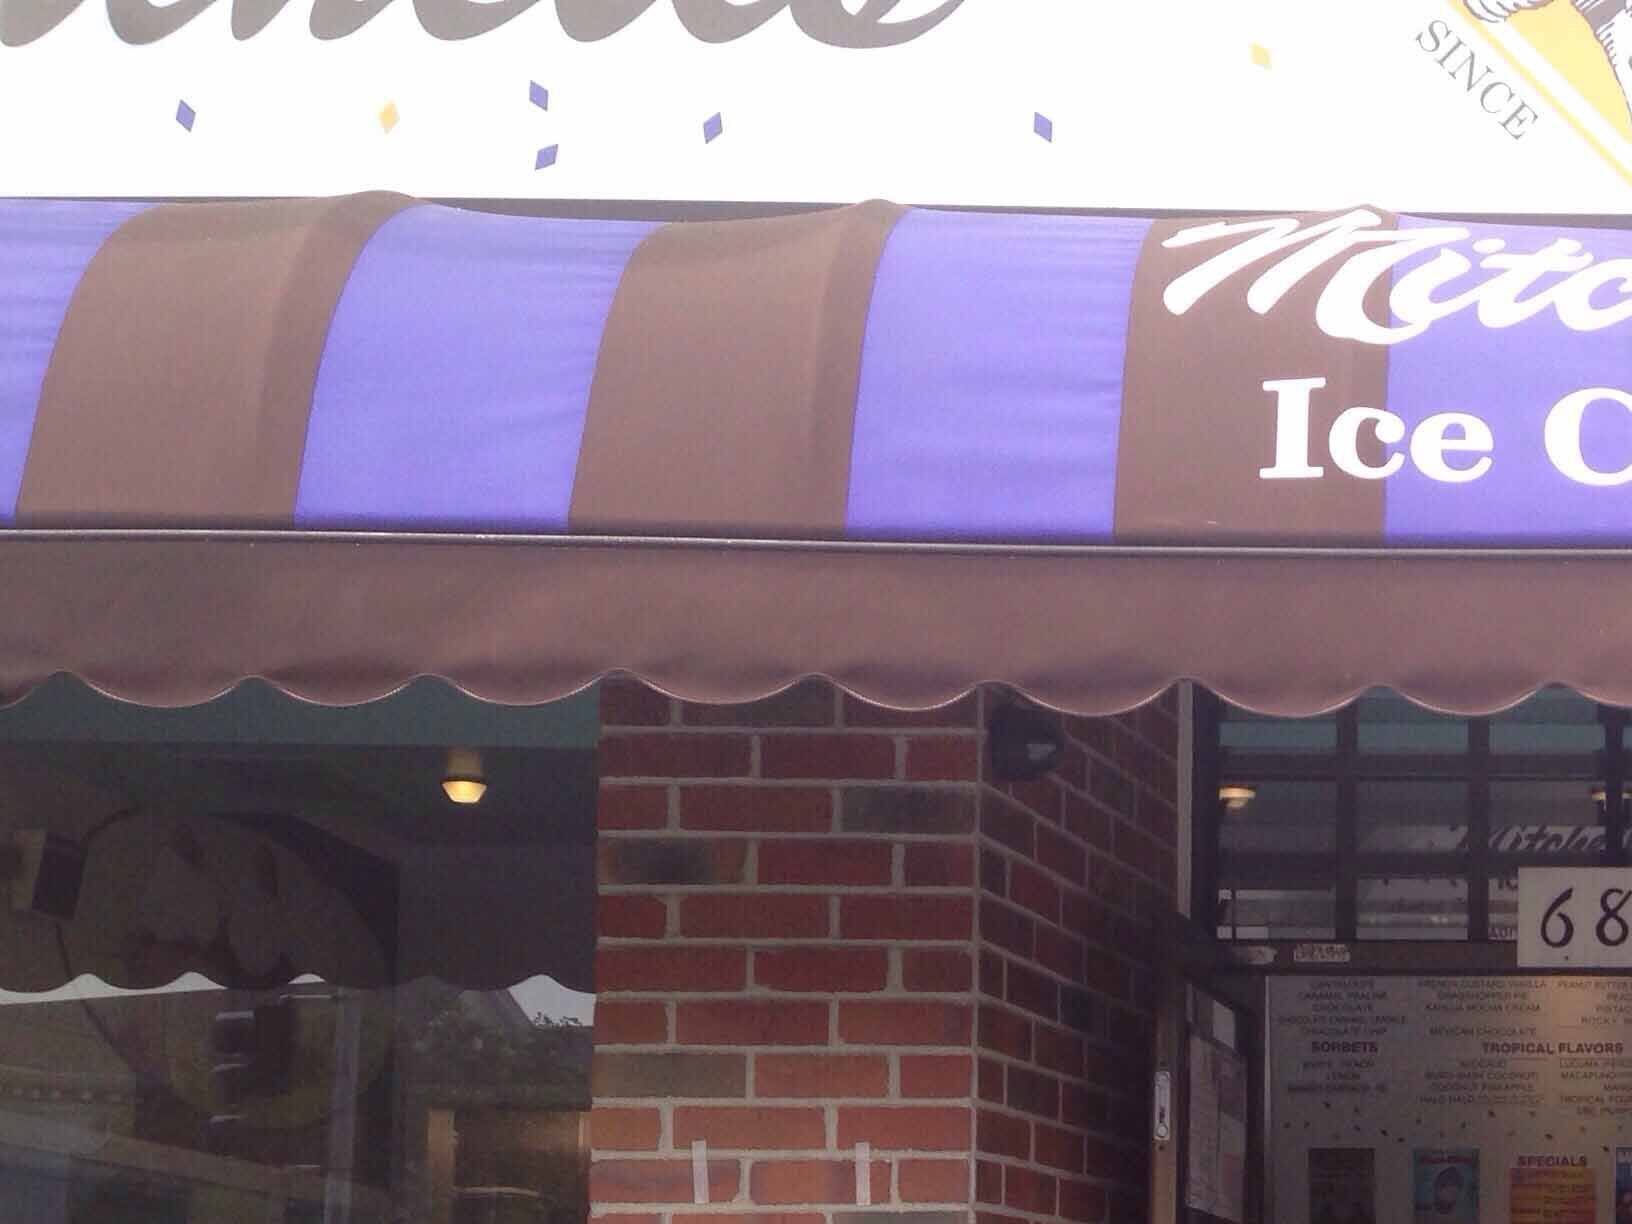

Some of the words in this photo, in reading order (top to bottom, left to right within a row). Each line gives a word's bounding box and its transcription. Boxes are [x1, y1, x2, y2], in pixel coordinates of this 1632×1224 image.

[1415, 19, 1538, 141] SINCE
[1259, 377, 1495, 481] Ice
[1311, 1041, 1378, 1053] SORBETS
[1482, 1041, 1553, 1054] TROPICAL
[1558, 1041, 1624, 1054] FLAVORS
[1517, 1154, 1588, 1167] SPECIALS
